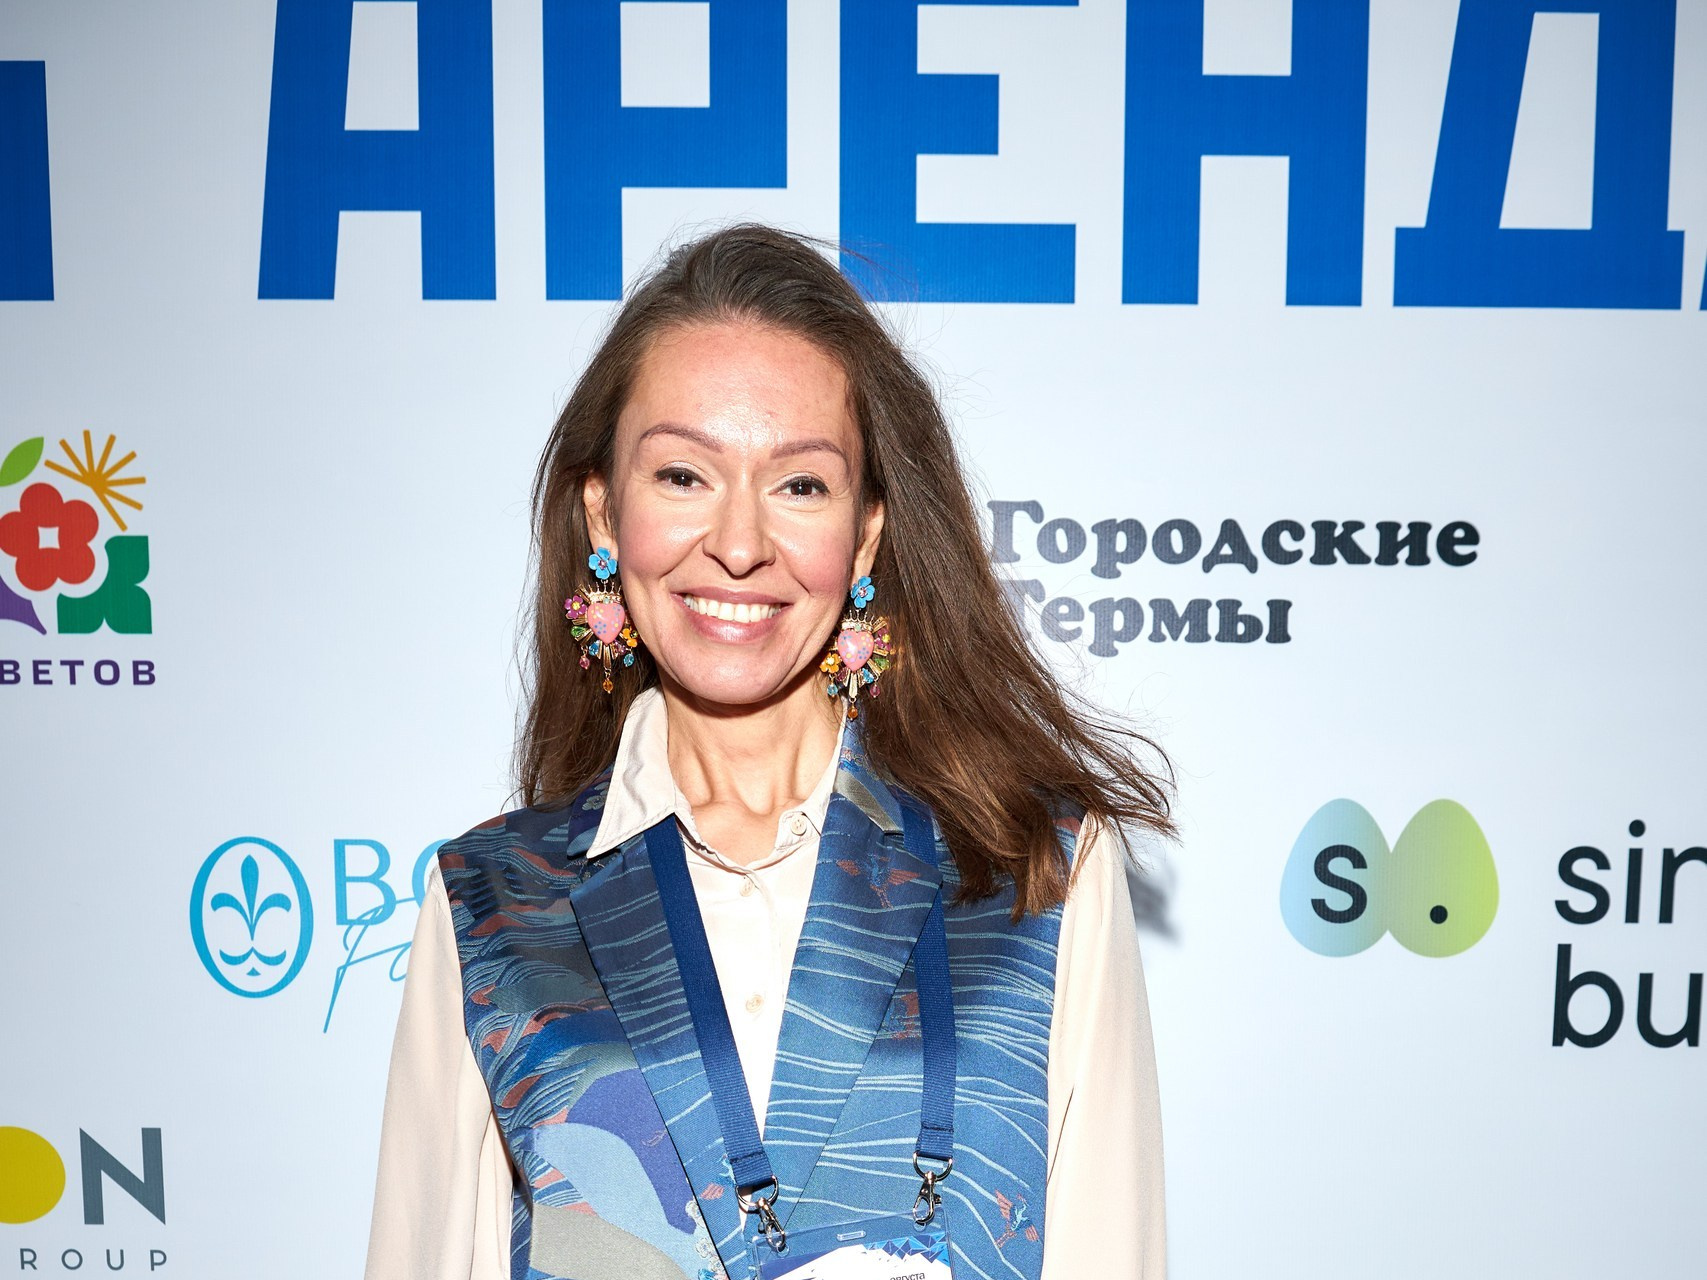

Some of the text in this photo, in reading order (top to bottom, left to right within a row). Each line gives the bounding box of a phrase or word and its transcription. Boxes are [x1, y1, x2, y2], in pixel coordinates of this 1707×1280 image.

[258, 0, 1707, 310] АРЕНД
[987, 500, 1480, 579] Городские
[20, 1247, 168, 1272] ROUP
